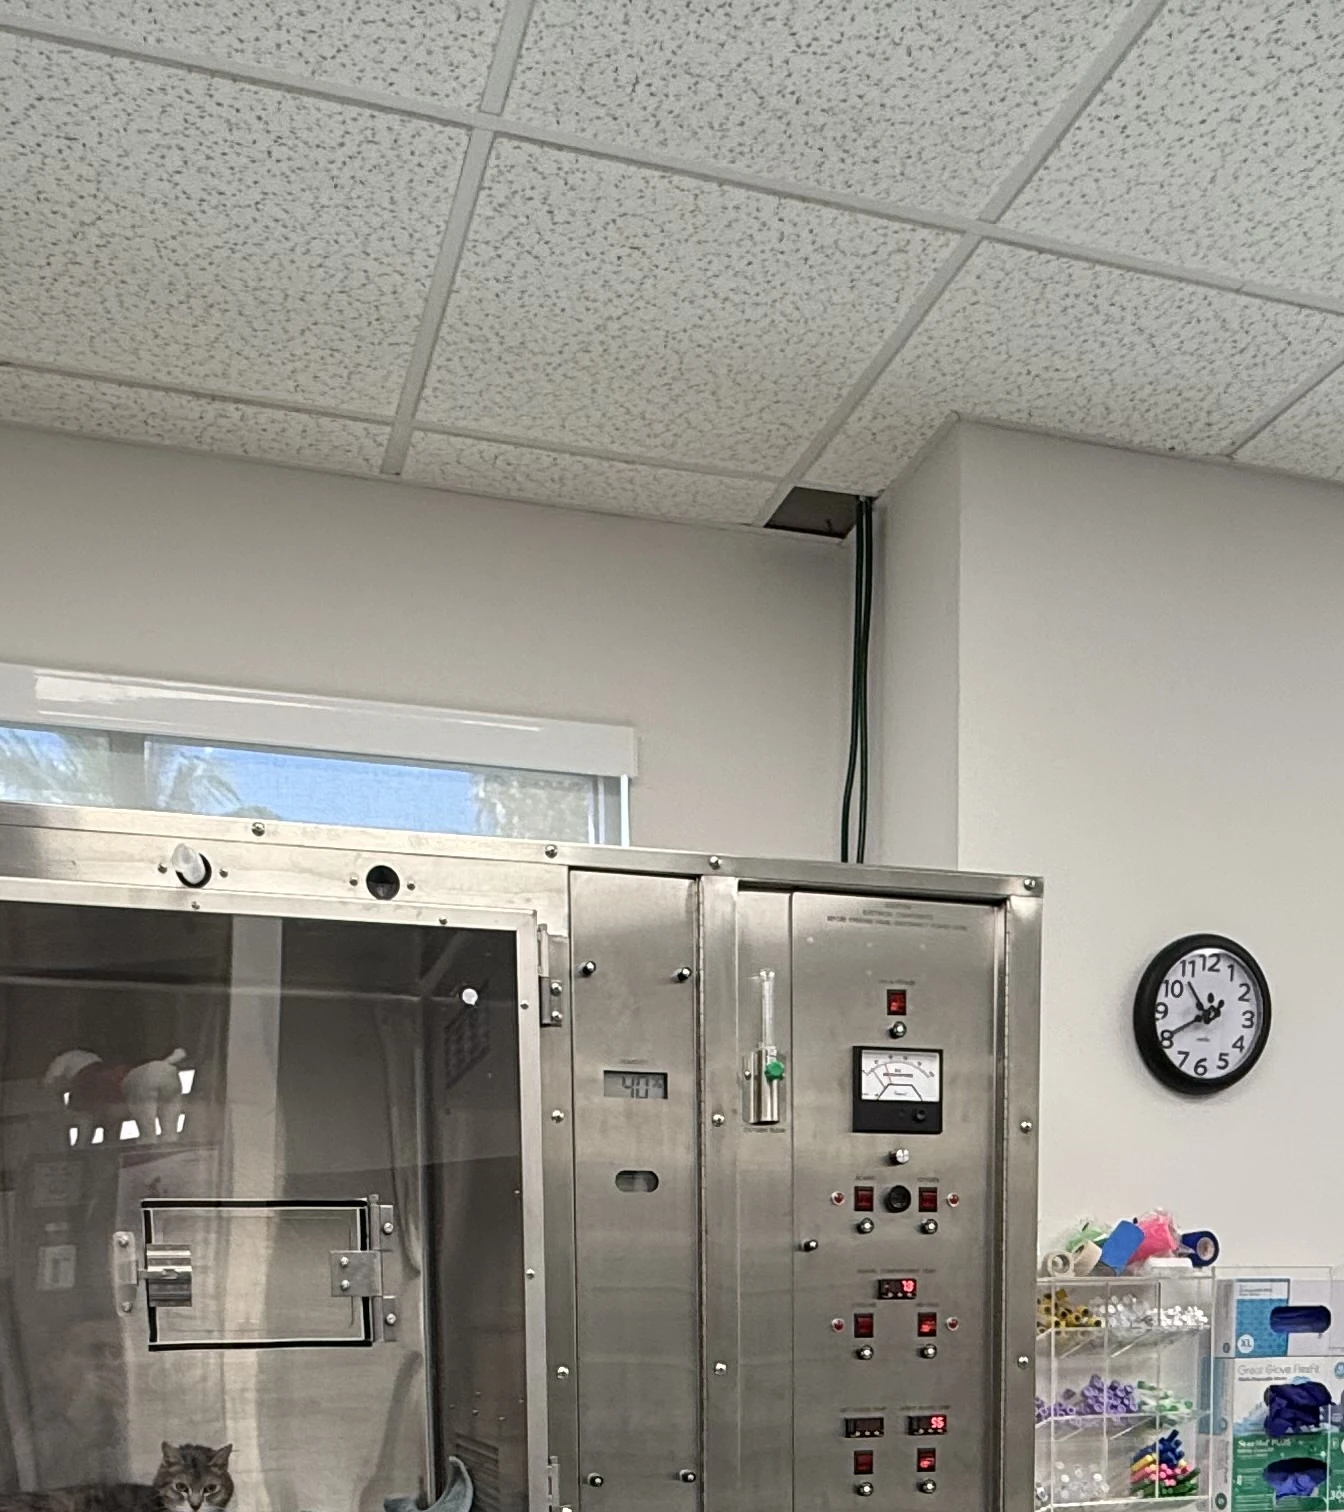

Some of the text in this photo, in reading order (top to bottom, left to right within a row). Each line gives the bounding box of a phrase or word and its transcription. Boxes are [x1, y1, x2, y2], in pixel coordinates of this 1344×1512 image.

[1179, 959, 1196, 978] 11
[1199, 953, 1221, 972] 12
[1227, 964, 1235, 982] 1
[1163, 979, 1184, 998] 10
[1238, 983, 1251, 1002] 2
[1155, 1001, 1169, 1022] 9
[1241, 1010, 1255, 1029] 3
[1160, 1029, 1175, 1049] 8
[1231, 1034, 1246, 1053] 4
[1177, 1051, 1191, 1068] 7
[1193, 1057, 1208, 1077] 6
[1216, 1052, 1230, 1070] 5
